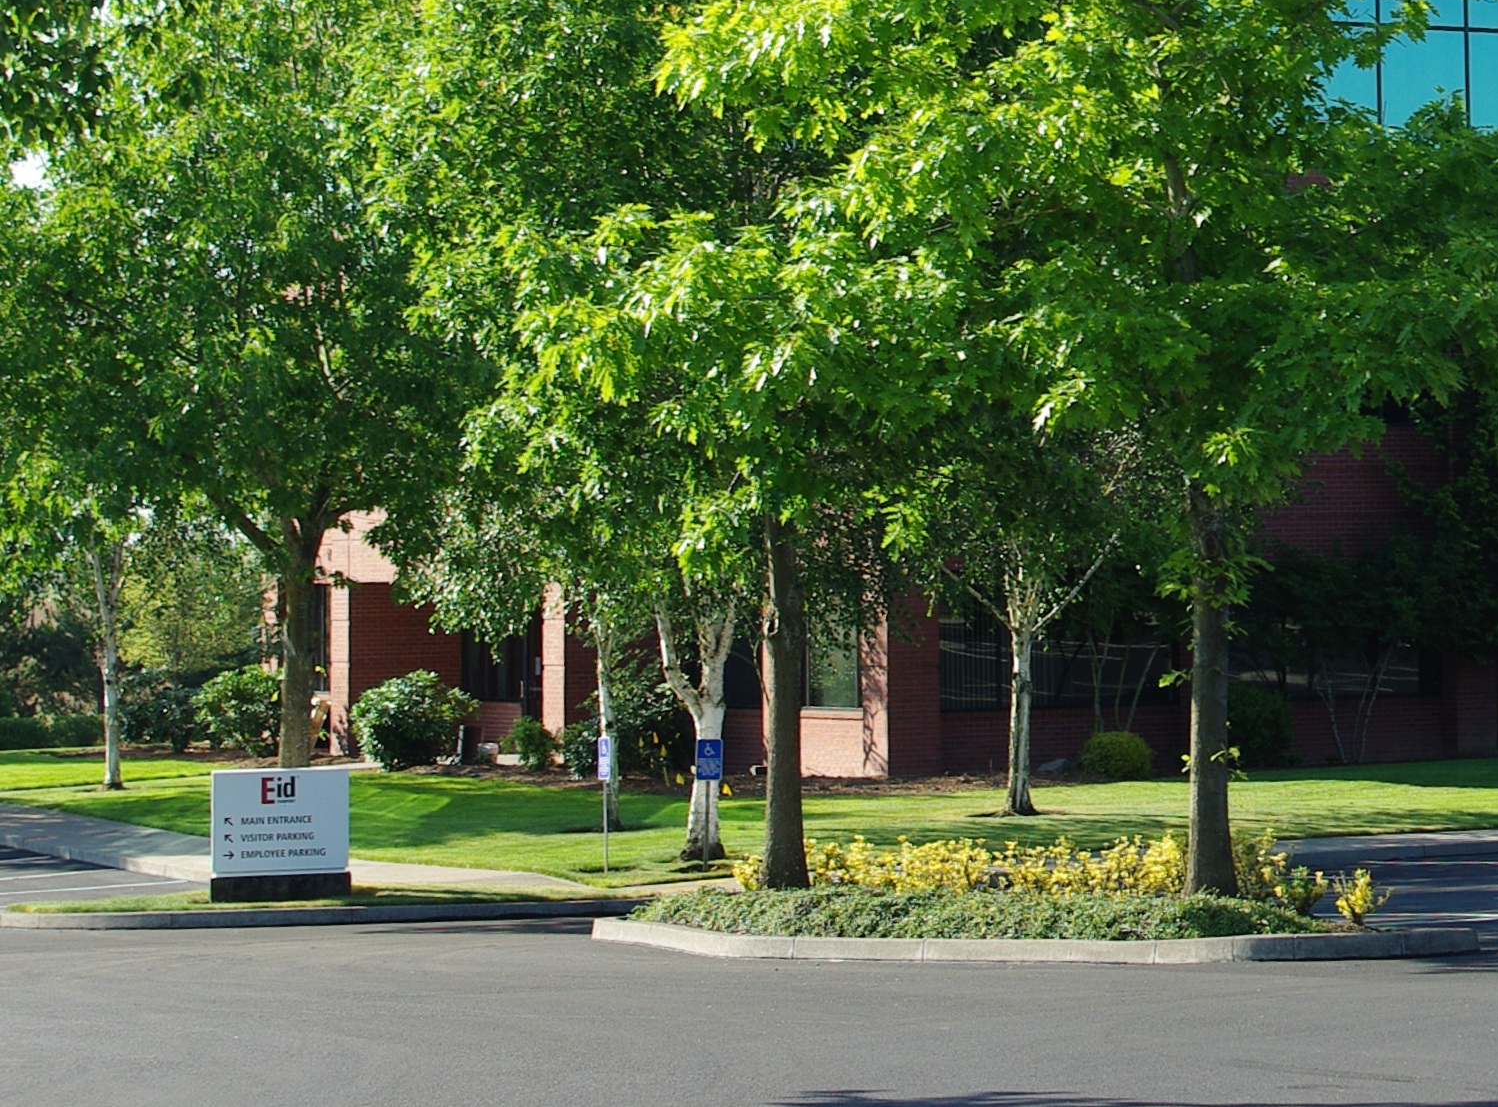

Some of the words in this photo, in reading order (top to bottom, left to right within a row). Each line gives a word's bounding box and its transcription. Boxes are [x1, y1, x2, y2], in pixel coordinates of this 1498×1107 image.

[261, 776, 296, 804] Eid
[240, 816, 265, 825] MAIN
[267, 815, 313, 825] ENTRANCE
[240, 833, 274, 843] VISITOR
[276, 832, 315, 842] PARKING
[241, 849, 285, 859] EMPLOYEE
[288, 847, 326, 857] PARKING
